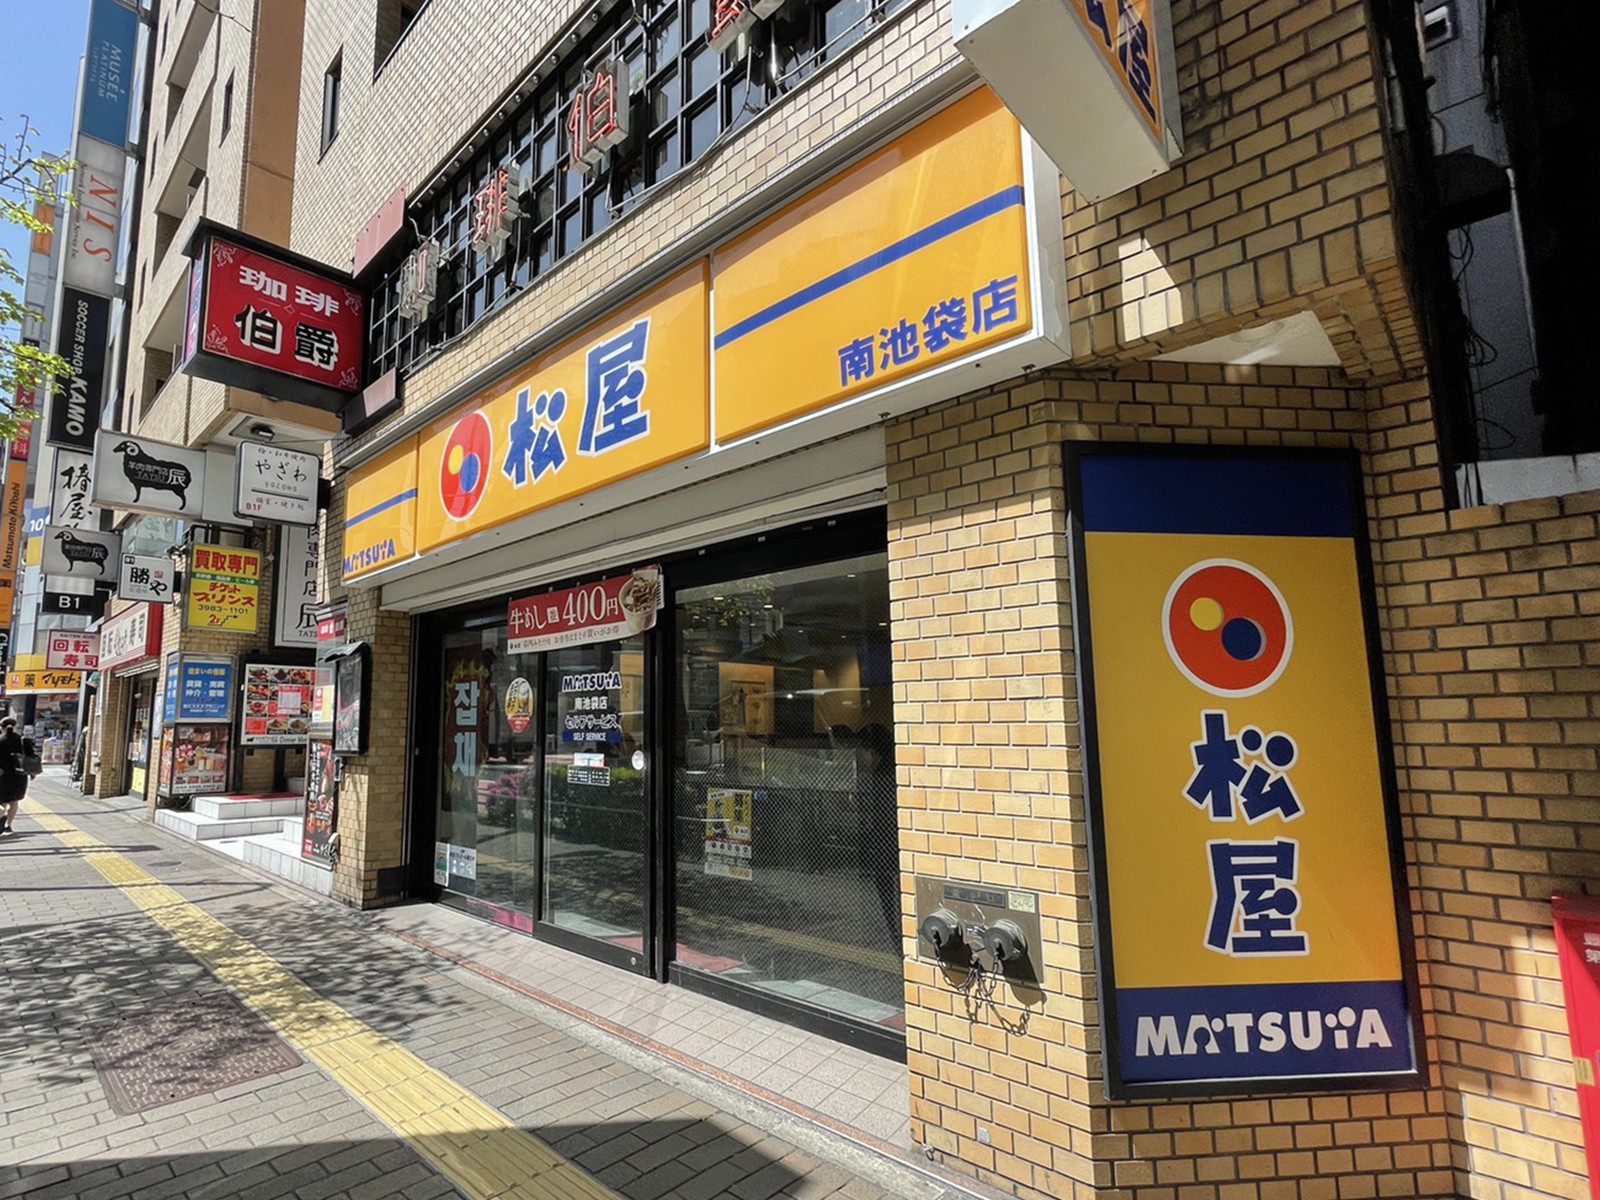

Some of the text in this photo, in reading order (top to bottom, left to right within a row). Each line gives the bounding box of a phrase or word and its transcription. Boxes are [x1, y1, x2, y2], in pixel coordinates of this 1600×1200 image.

[98, 40, 109, 97] PLATINUM
[106, 44, 125, 101] MUSÉE
[83, 174, 117, 262] NIS
[238, 265, 339, 317] 珈琲
[234, 304, 339, 371] 伯爵
[837, 275, 1018, 387] 南池袋店
[65, 299, 89, 436] SOCCER SHOP KAMO
[501, 315, 652, 490] 松屋
[166, 468, 186, 487] 辰
[255, 459, 307, 482] やざわ
[60, 463, 93, 529] 椿屋
[195, 549, 258, 576] 買取専門
[130, 567, 167, 596] 勝や
[209, 582, 241, 594] チケット
[58, 595, 80, 609] B1
[193, 591, 255, 607] プリンス
[509, 605, 547, 634] 牛めし
[562, 585, 619, 626] 400円
[53, 639, 89, 653] 回転
[63, 653, 99, 668] 寿司
[562, 671, 622, 692] MATSUYA
[574, 696, 608, 710] 南池袋店
[565, 713, 619, 729] セルフサービス
[573, 732, 607, 741] SELF SERVICE
[1182, 709, 1309, 957] 松屋
[1135, 1006, 1393, 1057] MATSUYA
